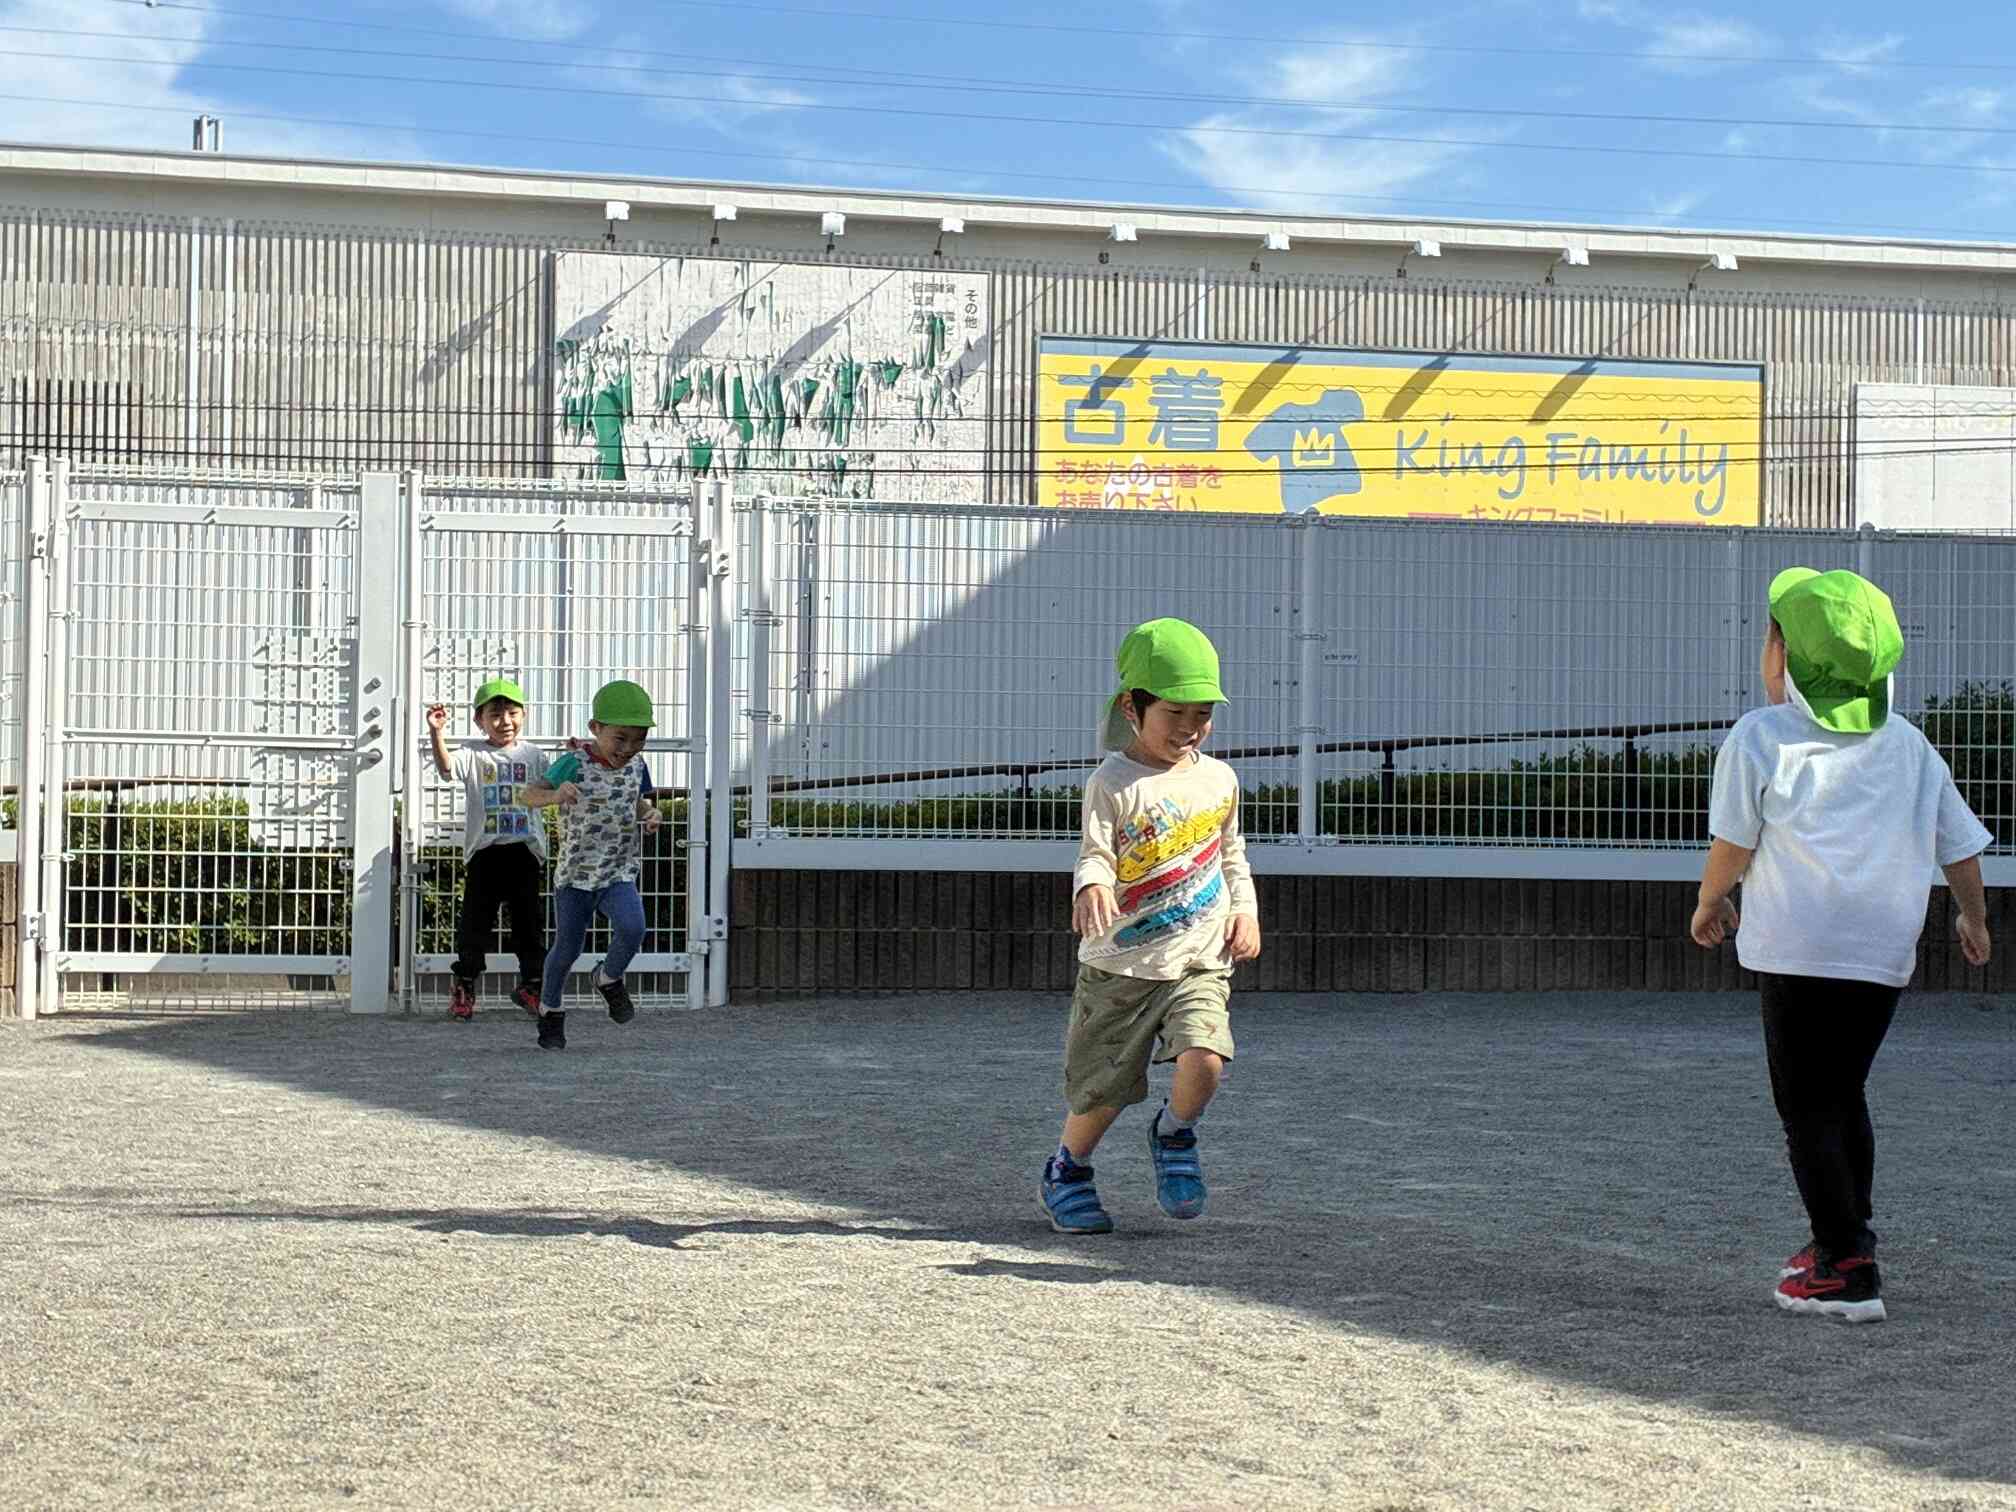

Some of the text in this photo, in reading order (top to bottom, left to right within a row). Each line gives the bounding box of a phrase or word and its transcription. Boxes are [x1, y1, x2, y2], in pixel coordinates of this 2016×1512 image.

[965, 289, 979, 330] その他
[1058, 364, 1225, 449] 古着
[1055, 459, 1222, 489] あなたの古着を
[1395, 411, 1727, 517] King Family
